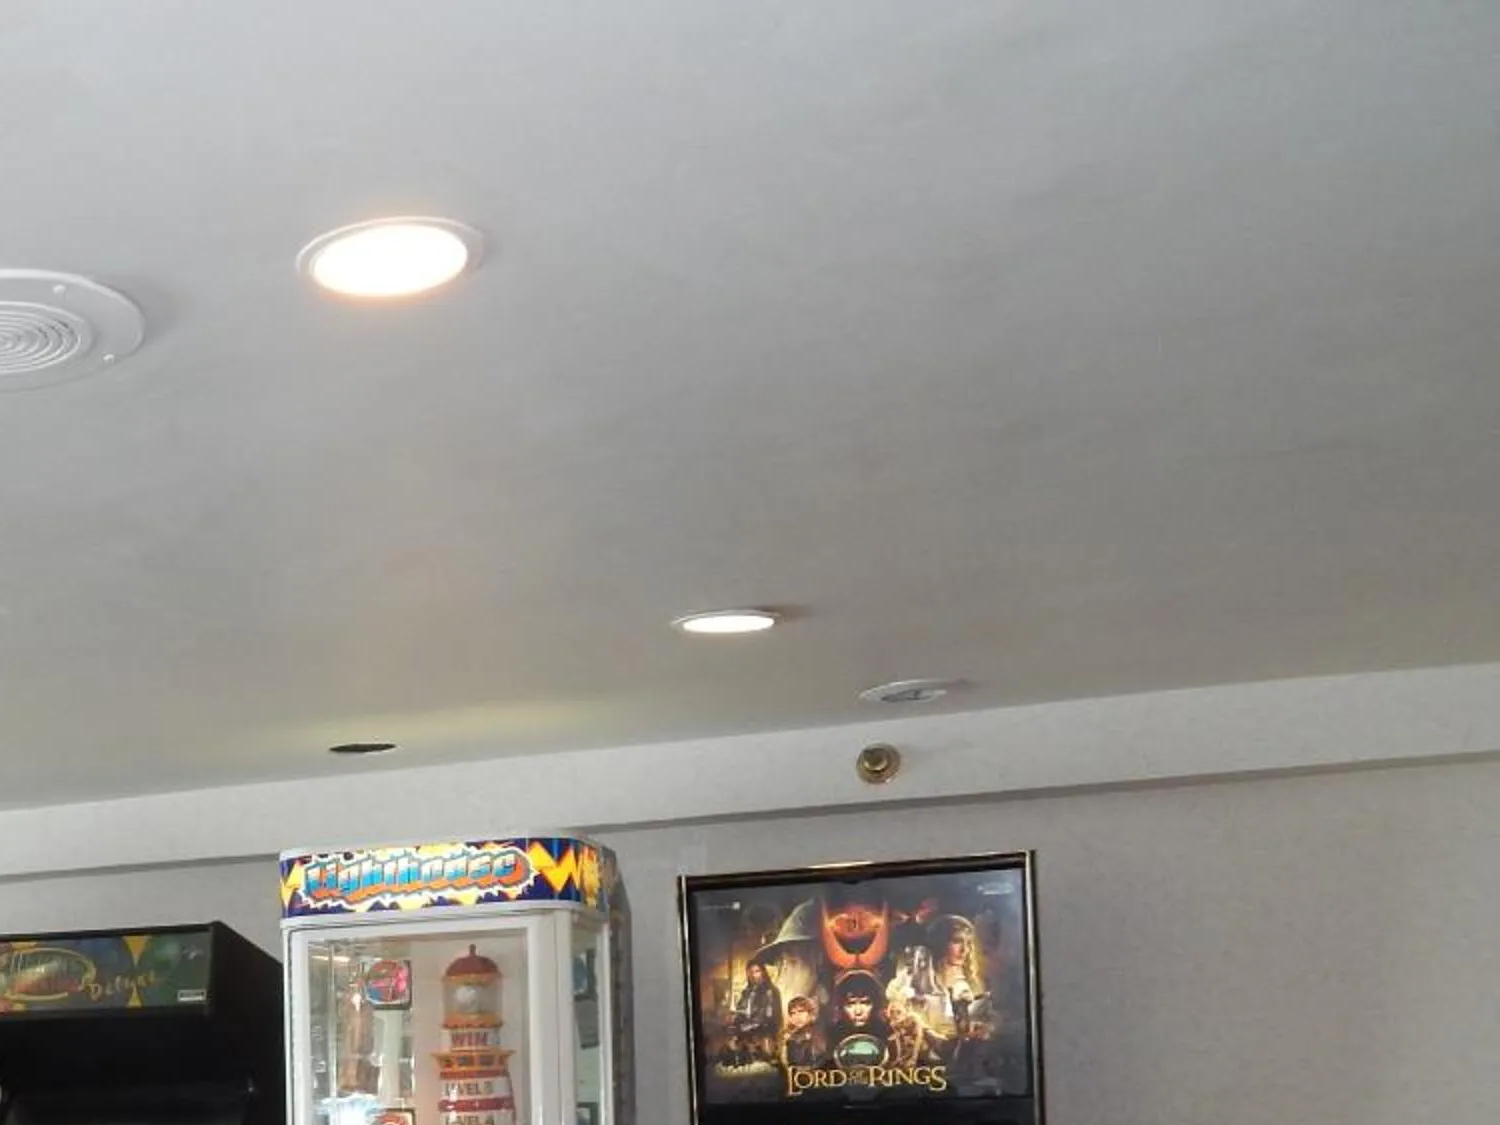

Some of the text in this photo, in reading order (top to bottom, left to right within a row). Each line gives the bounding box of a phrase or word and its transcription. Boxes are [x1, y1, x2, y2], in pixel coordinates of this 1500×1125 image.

[444, 1083, 480, 1096] LVEL
[787, 1065, 848, 1097] LORD
[867, 1064, 948, 1092] RINGS
